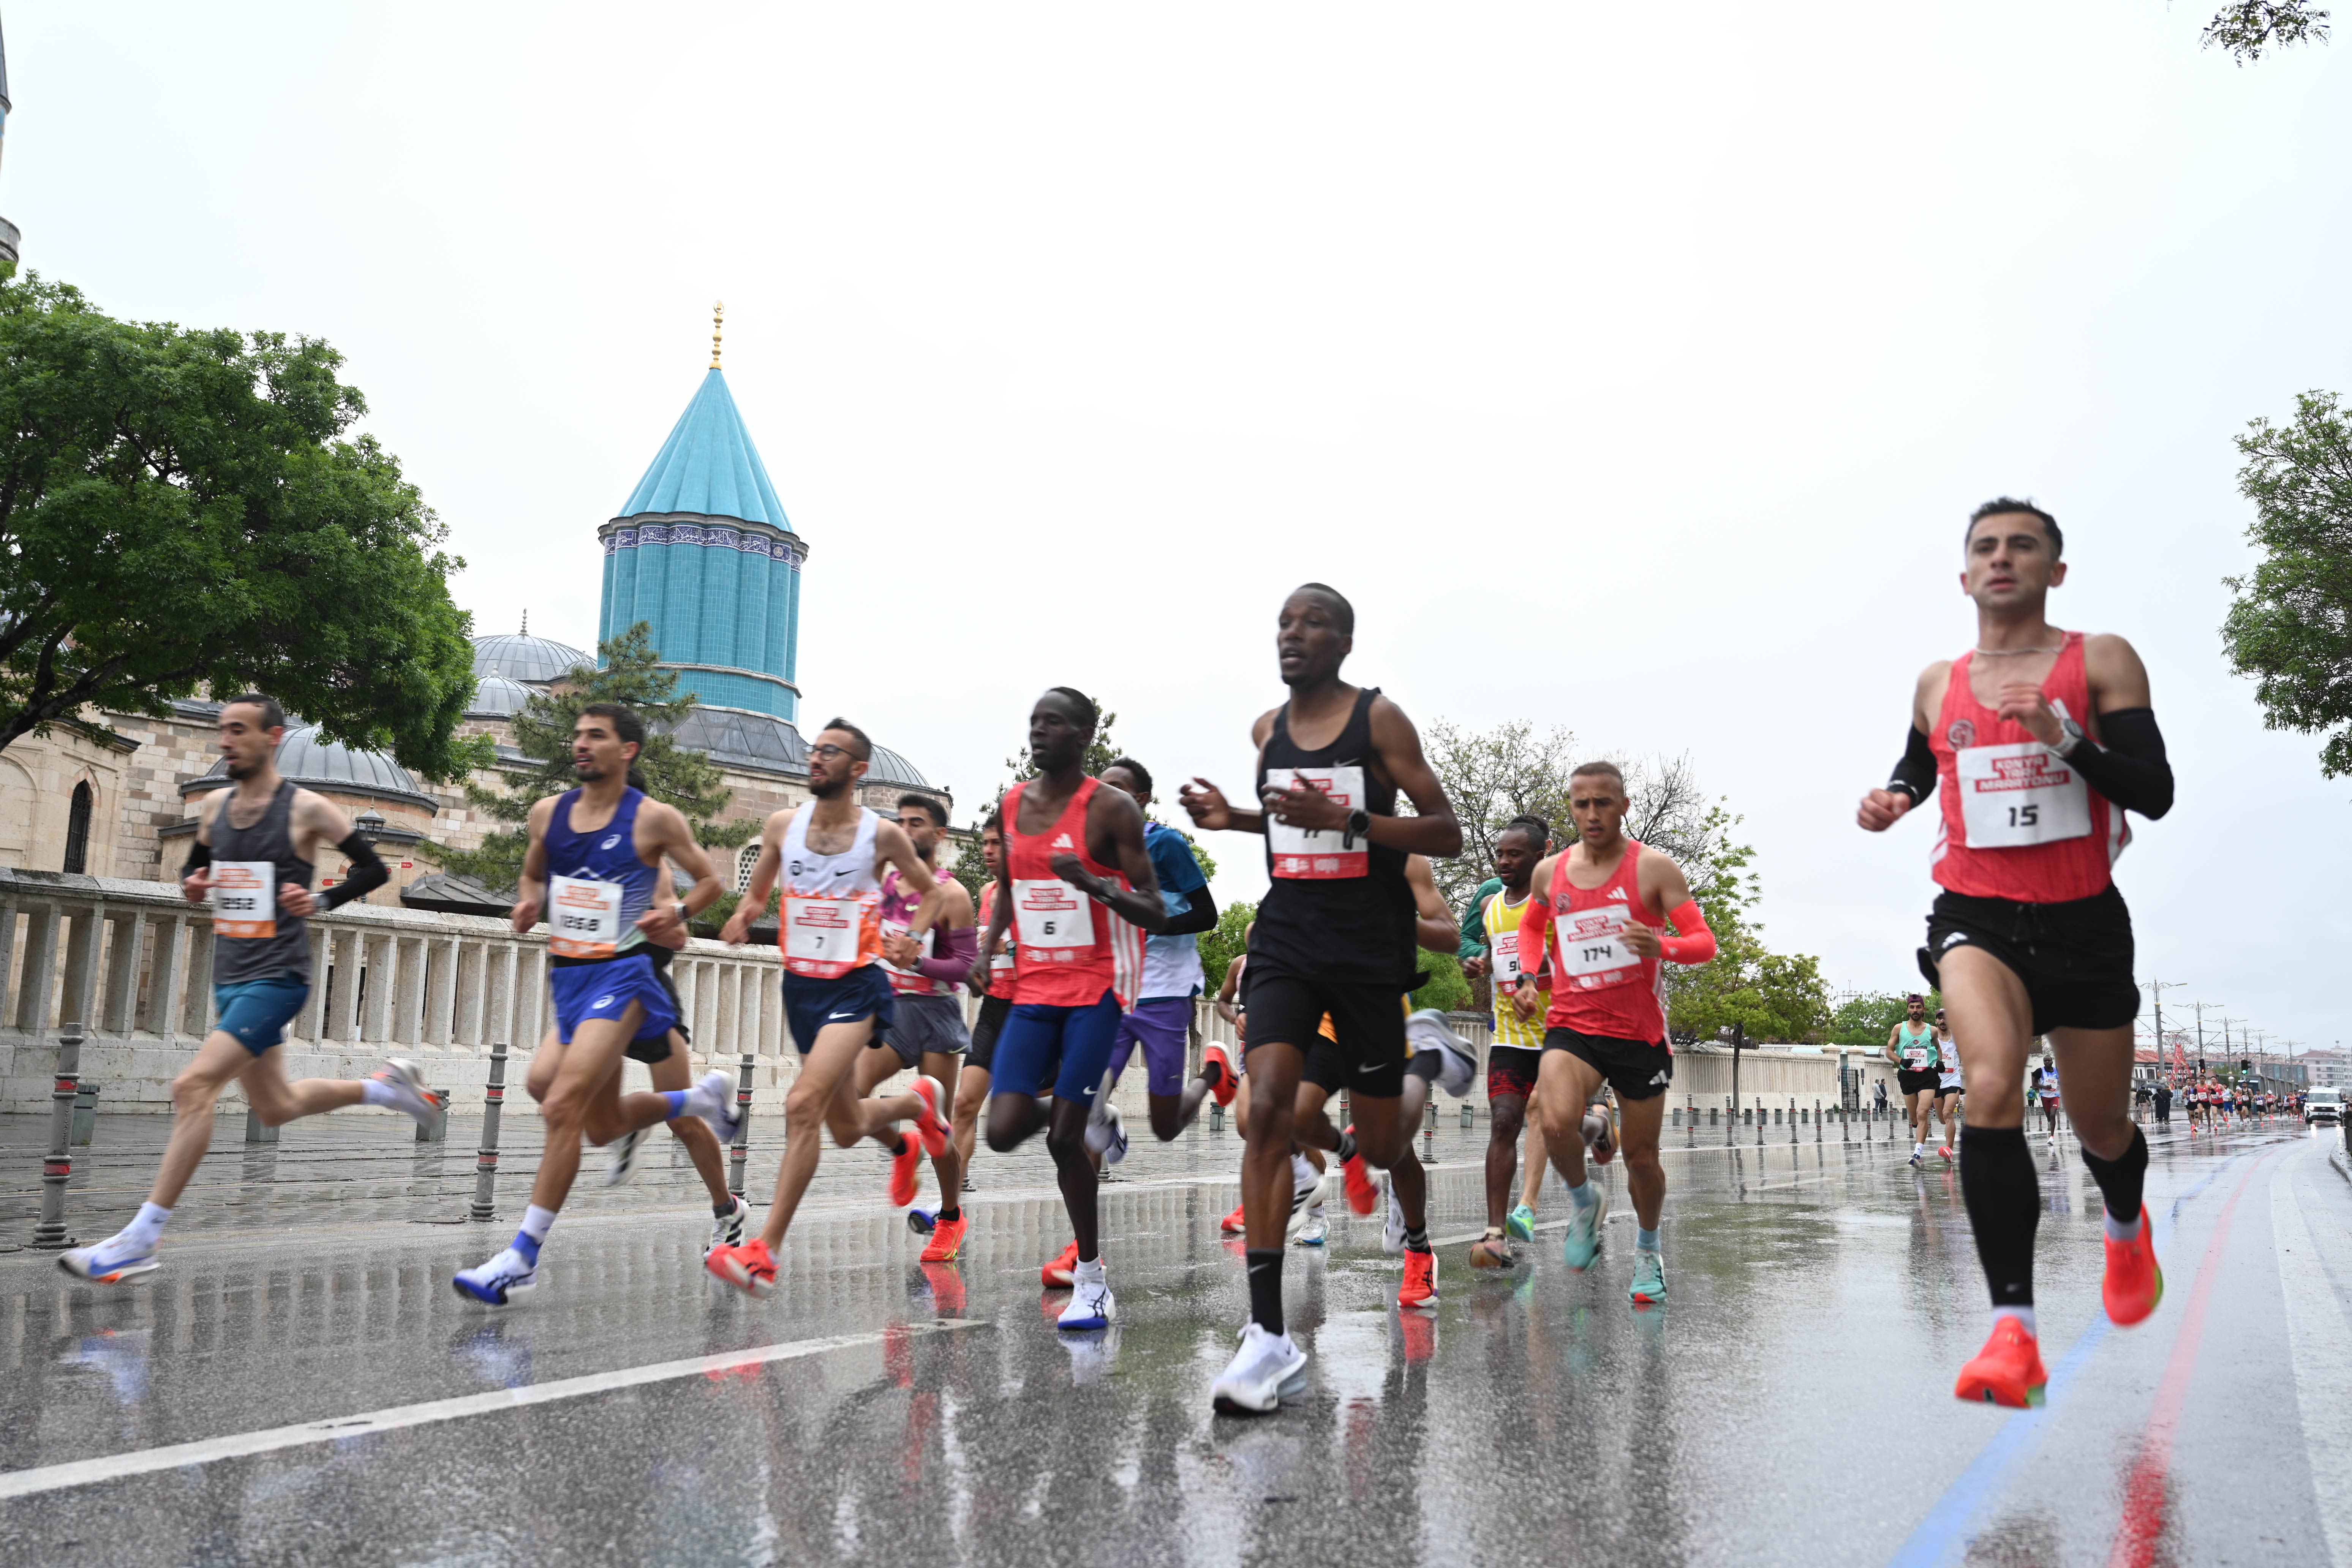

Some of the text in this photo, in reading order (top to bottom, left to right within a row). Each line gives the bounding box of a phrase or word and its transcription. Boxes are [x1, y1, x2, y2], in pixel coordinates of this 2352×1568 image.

[1995, 756, 2044, 770] KONYA
[2008, 804, 2039, 827] 15
[1044, 921, 1055, 934] 6
[816, 936, 825, 948] 7
[1583, 945, 1612, 962] 174
[1510, 961, 1521, 971] 9
